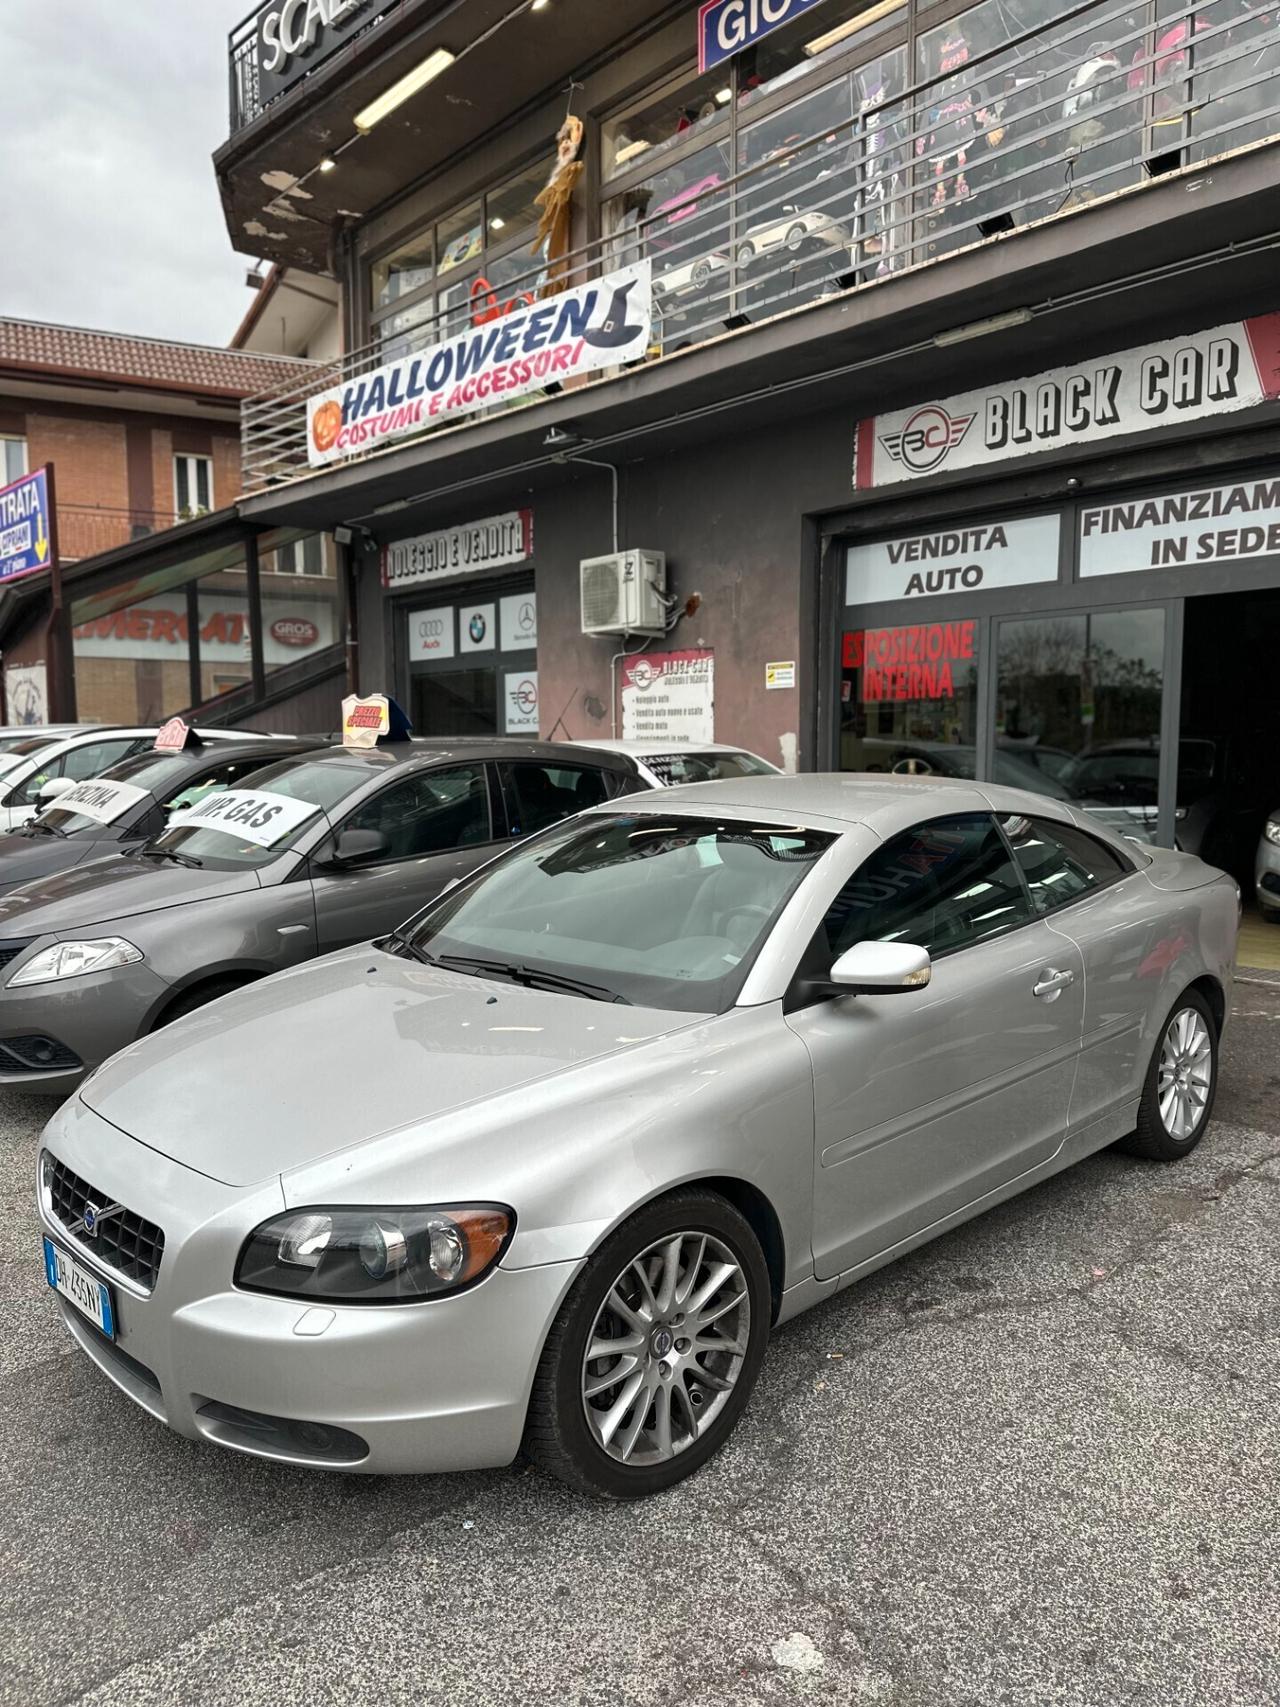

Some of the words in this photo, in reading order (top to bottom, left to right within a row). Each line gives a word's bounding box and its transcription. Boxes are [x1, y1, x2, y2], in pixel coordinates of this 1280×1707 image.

[342, 290, 598, 425] HALLOWEEN
[337, 403, 422, 449] COSTUMI
[429, 393, 444, 416] E
[447, 338, 585, 410] ACCESSORI
[985, 365, 1122, 450] BLACK
[1139, 337, 1239, 415] CAR
[388, 536, 447, 579] NOLEGGIO
[451, 533, 459, 567] E
[462, 518, 524, 563] VENDITA
[887, 526, 1008, 564] VENDITA
[1151, 536, 1188, 565] IN
[1196, 523, 1280, 560] SEDE
[904, 564, 983, 595] AUTO
[274, 621, 314, 635] GROS
[863, 661, 953, 701] INTERNA
[223, 800, 283, 828] GAS
